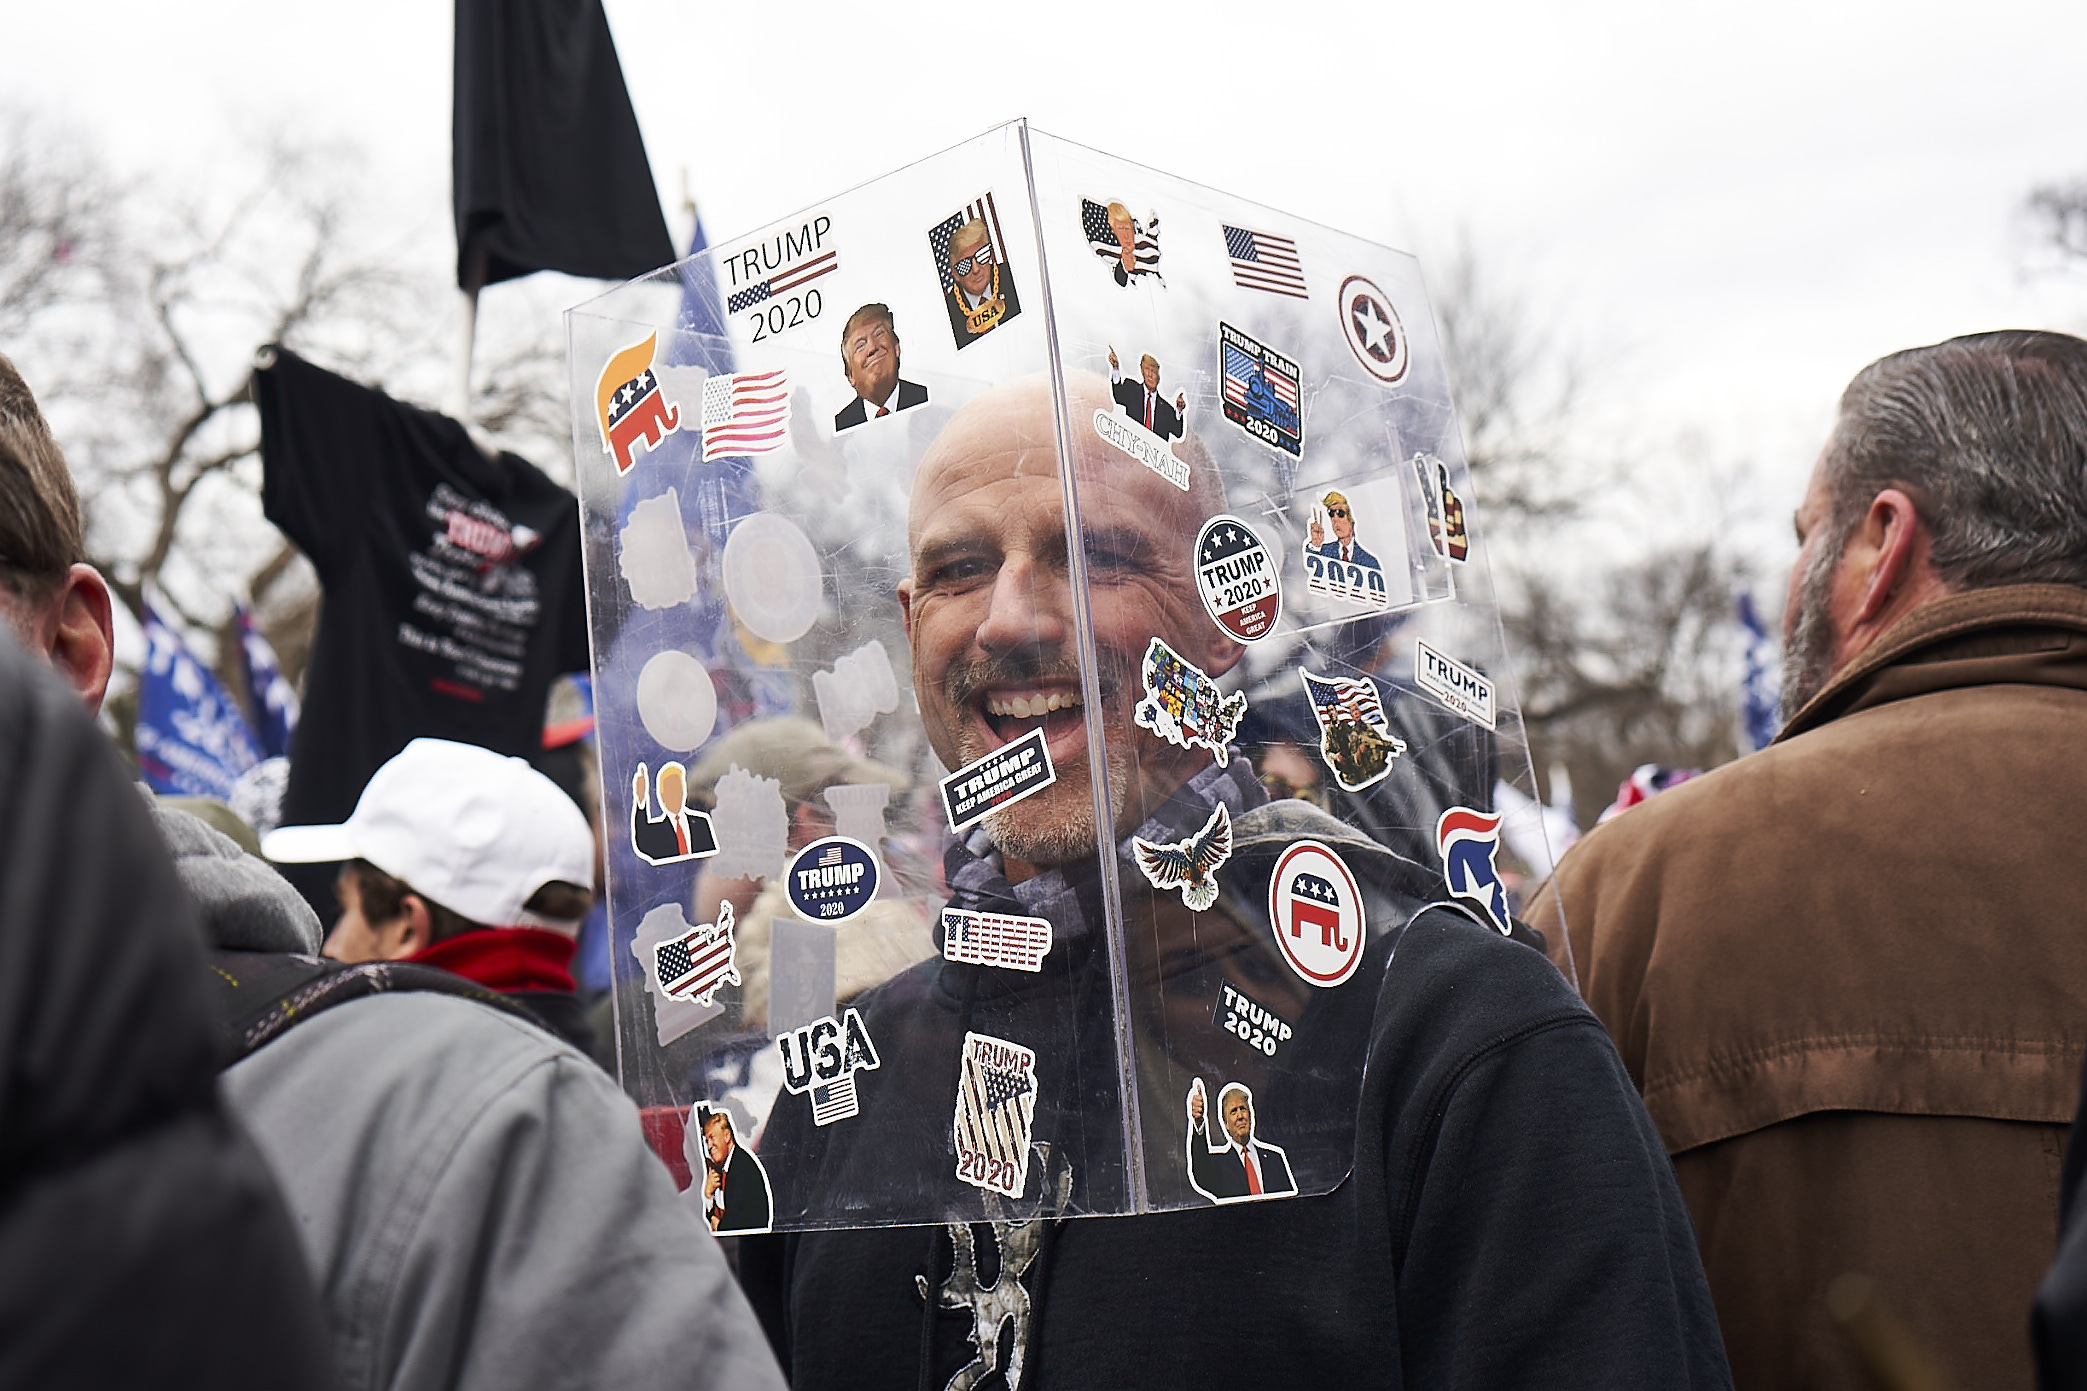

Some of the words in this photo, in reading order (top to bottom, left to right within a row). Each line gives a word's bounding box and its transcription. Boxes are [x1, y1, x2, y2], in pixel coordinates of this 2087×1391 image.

[723, 216, 831, 285] TRUMP
[750, 289, 822, 343] 2020
[972, 306, 999, 327] USA
[1222, 326, 1261, 356] TRUMP
[1263, 350, 1298, 379] TRAIN
[1096, 414, 1188, 487] CHY-NAH
[1246, 416, 1279, 444] 2020
[1202, 551, 1264, 589] TRUMP
[1224, 578, 1262, 607] 2020
[1306, 555, 1387, 607] 2020
[1239, 610, 1267, 627] AMERICA
[1245, 621, 1266, 635] GREAT
[1425, 651, 1488, 701] TRUMP
[1444, 691, 1467, 712] 2020
[953, 747, 1036, 800] TRUMP
[955, 796, 977, 815] KEEP
[976, 776, 1016, 805] AMERICA
[1015, 761, 1042, 784] GREAT
[797, 862, 865, 891] TRUMP
[820, 901, 845, 917] 2020
[945, 913, 1048, 966] TRUMP
[1223, 985, 1292, 1042] TRUMP
[1223, 1011, 1277, 1057] 2020
[780, 1014, 877, 1089] USA
[973, 1039, 1032, 1075] TRUMP
[959, 1150, 1015, 1190] 2020
